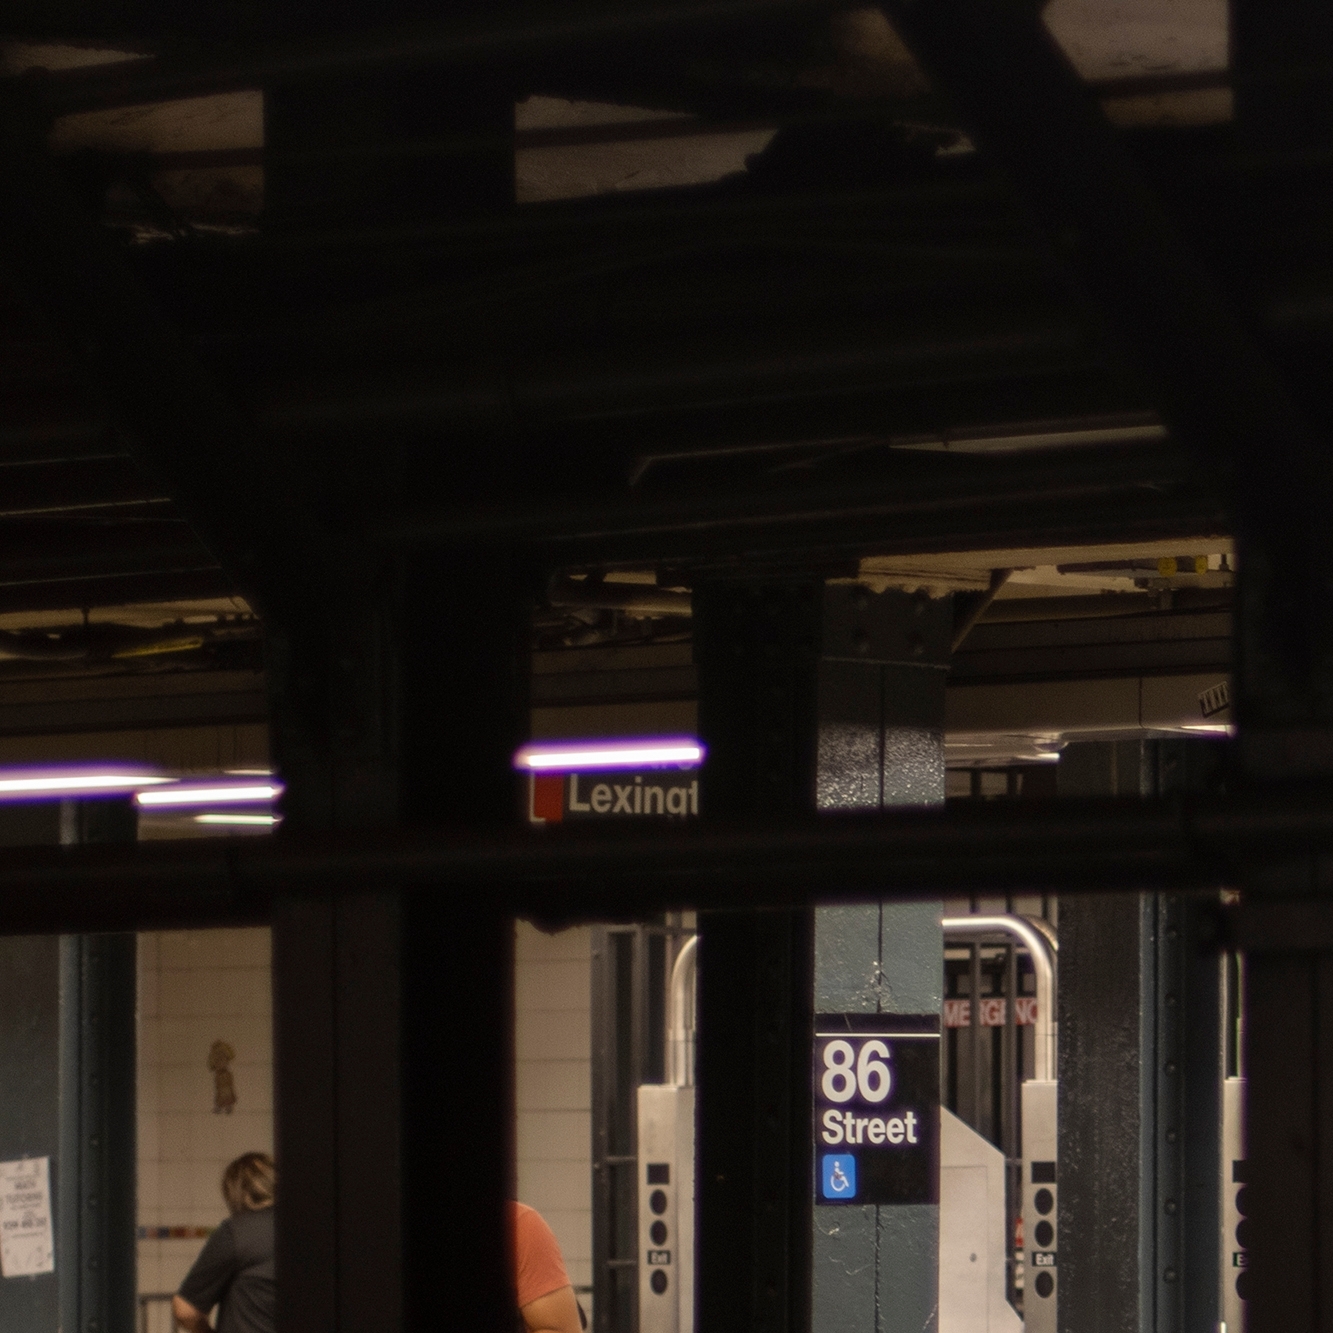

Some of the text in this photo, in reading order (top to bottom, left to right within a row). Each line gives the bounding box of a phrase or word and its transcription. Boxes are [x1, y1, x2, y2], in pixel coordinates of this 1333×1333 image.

[822, 1040, 891, 1103] 86
[822, 1109, 917, 1145] Street
[1035, 1253, 1054, 1266] Exit
